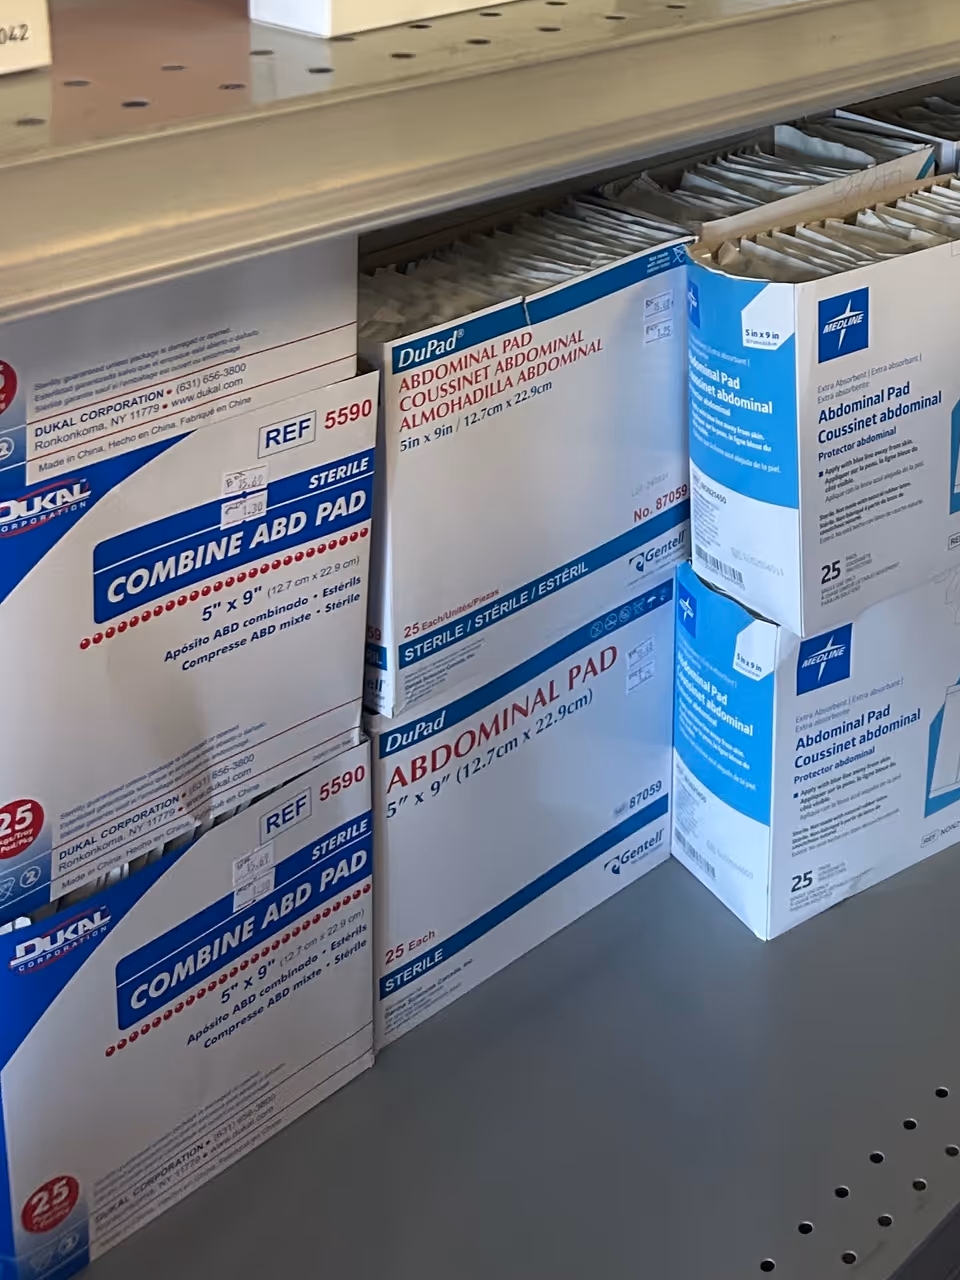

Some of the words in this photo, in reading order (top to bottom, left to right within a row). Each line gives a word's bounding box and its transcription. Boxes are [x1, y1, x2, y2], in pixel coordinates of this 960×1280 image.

[822, 314, 864, 333] MEDLINE
[399, 345, 498, 393] ABDOMINAL
[503, 332, 532, 354] PAD
[400, 365, 491, 412] COUSSINET
[495, 330, 584, 376] ABDOMINAL
[400, 376, 514, 432] ALMOHADILLA
[517, 339, 603, 385] ABDOMINAL
[34, 421, 107, 451] Ronkonkoma,
[111, 414, 128, 427] NY
[130, 404, 160, 420] 11779
[171, 377, 243, 408] www.dukal.com
[35, 417, 76, 437] DUKAL
[80, 389, 164, 423] CORPORATION
[176, 376, 202, 394] (631)
[203, 363, 247, 384] 656-3800
[265, 419, 311, 448] REF
[324, 399, 372, 430] 5590
[400, 436, 420, 452] 5in
[424, 433, 431, 442] x
[434, 425, 453, 439] 9in
[464, 403, 502, 427] 12.7cm
[506, 400, 512, 409] x
[514, 380, 552, 404] 22.9cm
[818, 388, 884, 424] Abdominal
[887, 381, 910, 403] Pad
[818, 414, 877, 444] Coussinet
[879, 391, 942, 422] abdominal
[818, 442, 854, 461] Protector
[856, 426, 897, 449] abdominal
[308, 457, 369, 489] STERILE
[633, 507, 652, 522] No.
[656, 484, 688, 510] 87059
[107, 532, 244, 603] COMBINE
[250, 511, 306, 549] ABD
[315, 490, 366, 526] PAD
[646, 529, 686, 562] Gentell
[821, 561, 841, 584] 25
[164, 634, 210, 662] Apósito
[214, 623, 239, 639] ABD
[243, 597, 308, 627] combinado
[182, 637, 247, 671] Compresse
[251, 625, 276, 642] ABD
[279, 611, 311, 630] mixte
[325, 593, 360, 613] Stérile
[405, 627, 463, 662] STERILE
[475, 590, 529, 628] STÉRILE
[538, 561, 589, 594] ESTÉRIL
[385, 710, 446, 752] DuPad
[386, 681, 560, 795] ABDOMINAL
[568, 646, 618, 690] PAD
[319, 765, 366, 802] 5590
[629, 780, 662, 809] 87059
[621, 828, 664, 865] Gentell
[13, 910, 111, 961] DUKAL
[19, 926, 107, 971] CORPORATION
[130, 917, 254, 1010] COMBINE
[261, 882, 312, 929] ABD
[320, 850, 367, 892] PAD
[385, 948, 443, 993] STERILE
